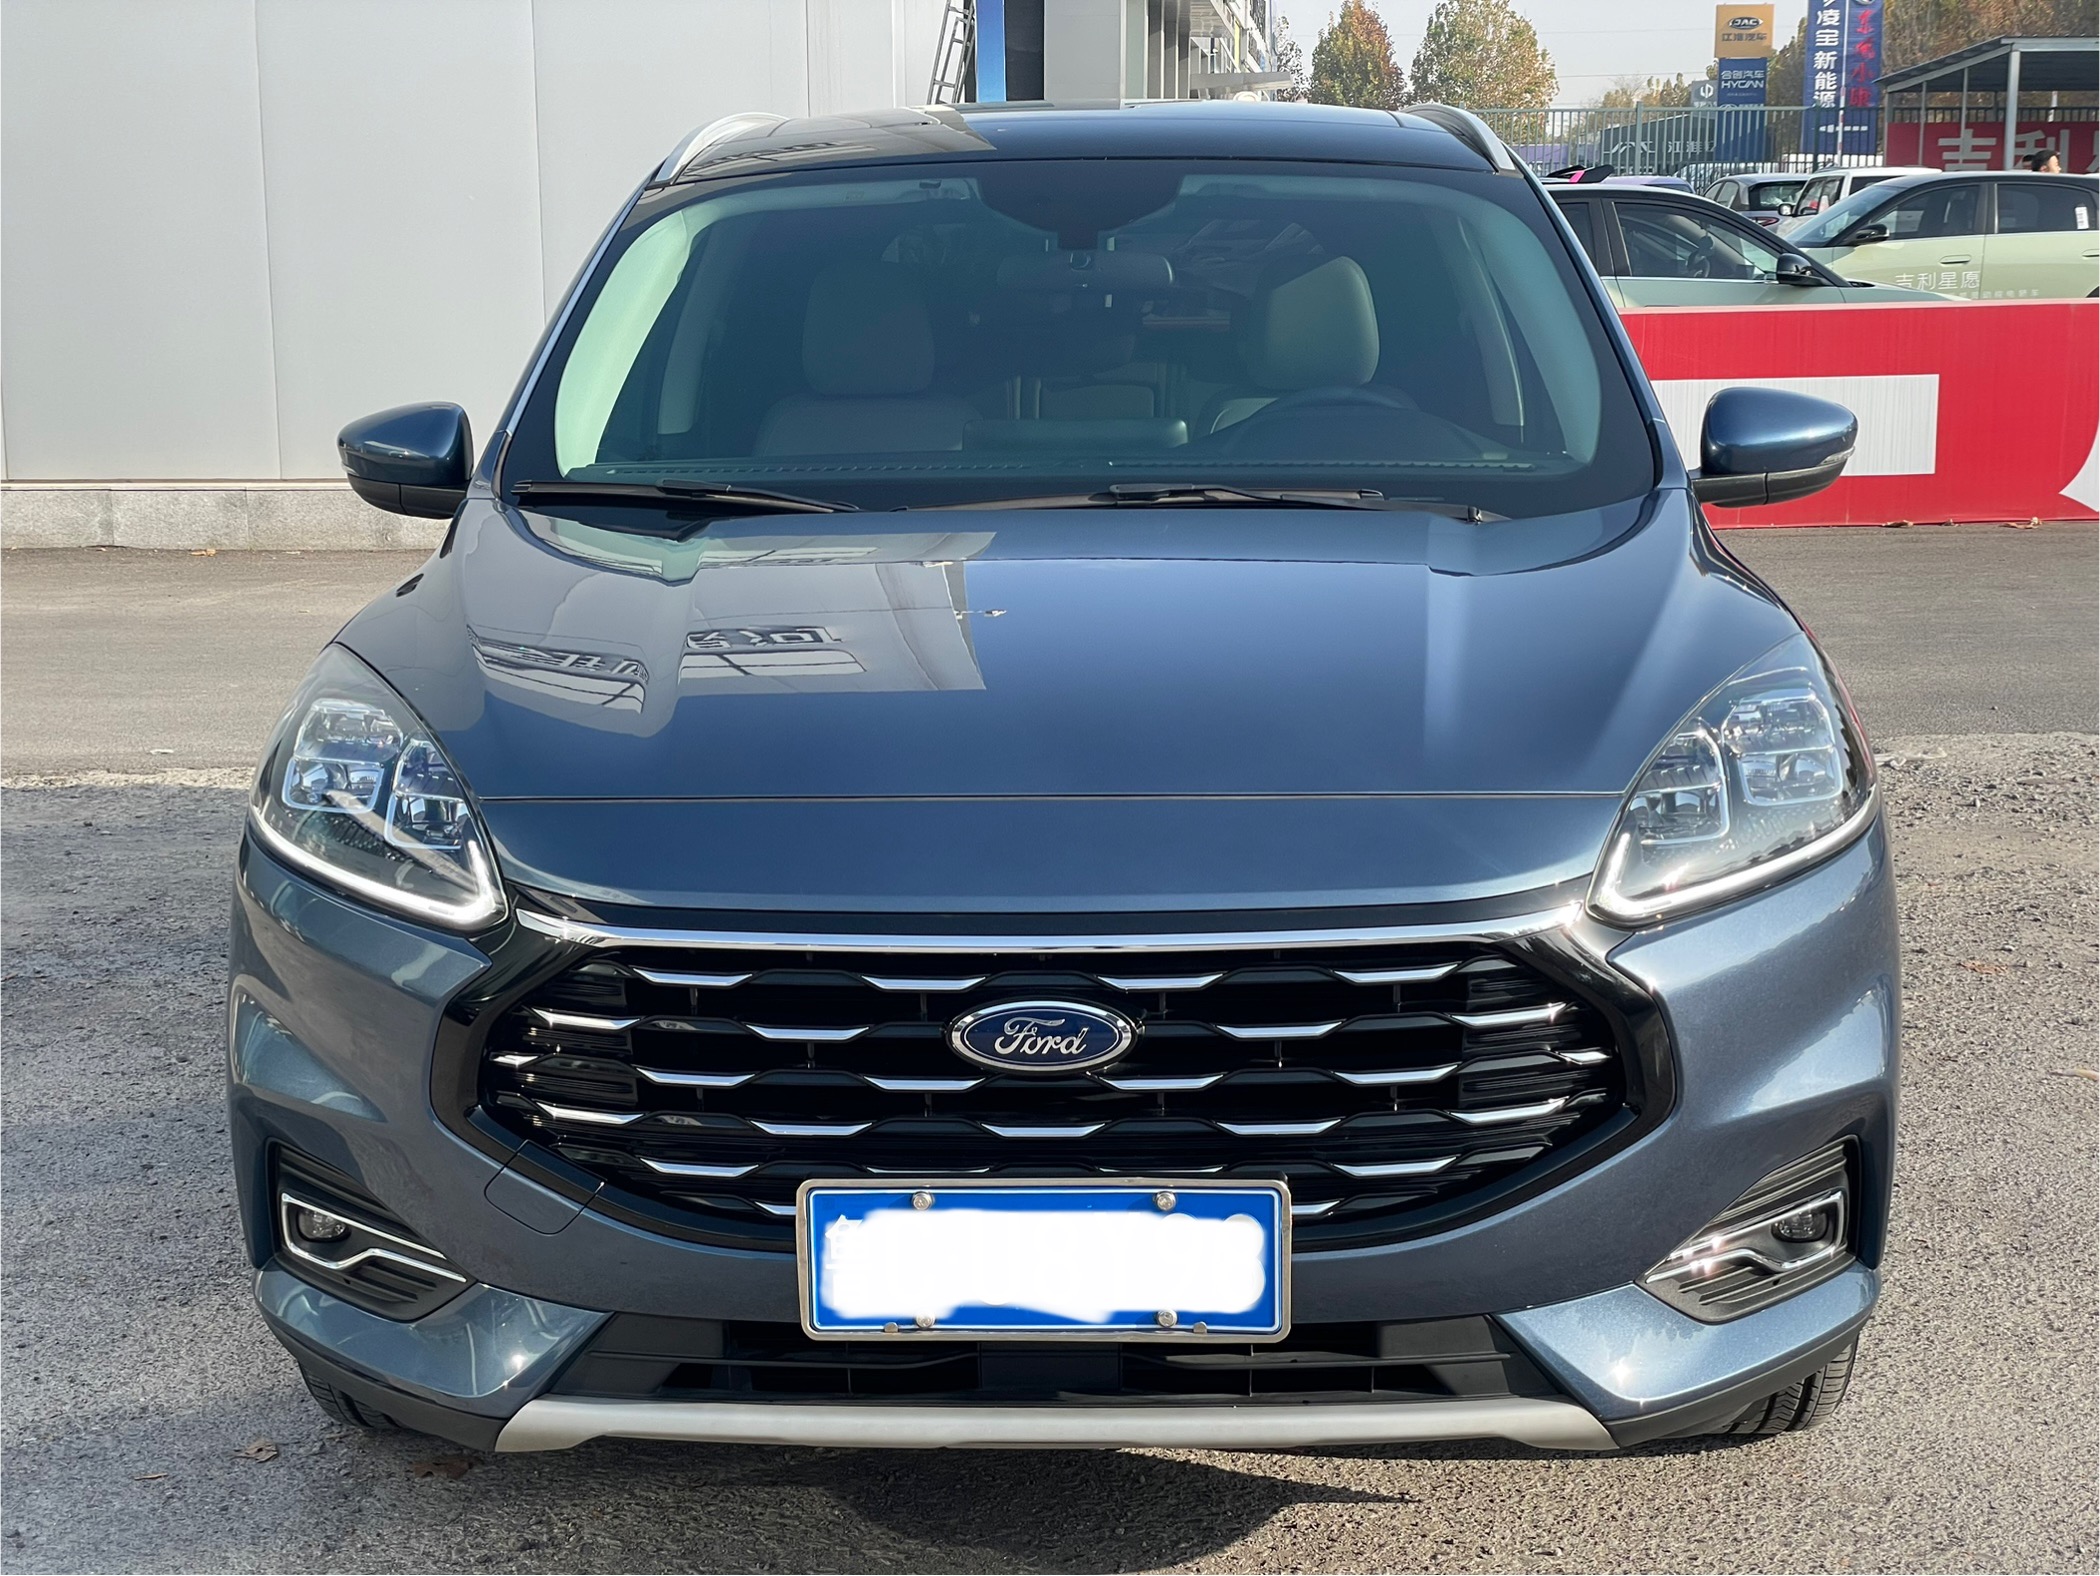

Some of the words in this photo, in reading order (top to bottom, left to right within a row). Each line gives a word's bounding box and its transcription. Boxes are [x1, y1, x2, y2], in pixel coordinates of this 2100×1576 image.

[1733, 18, 1758, 26] JAC
[1813, 0, 1841, 108] 凌宝新能源
[1721, 70, 1765, 80] 合创汽车
[1721, 80, 1764, 89] HYCAN
[1938, 129, 2099, 172] 吉利
[1895, 270, 1981, 291] 吉利星愿
[994, 1016, 1090, 1055] Ford
